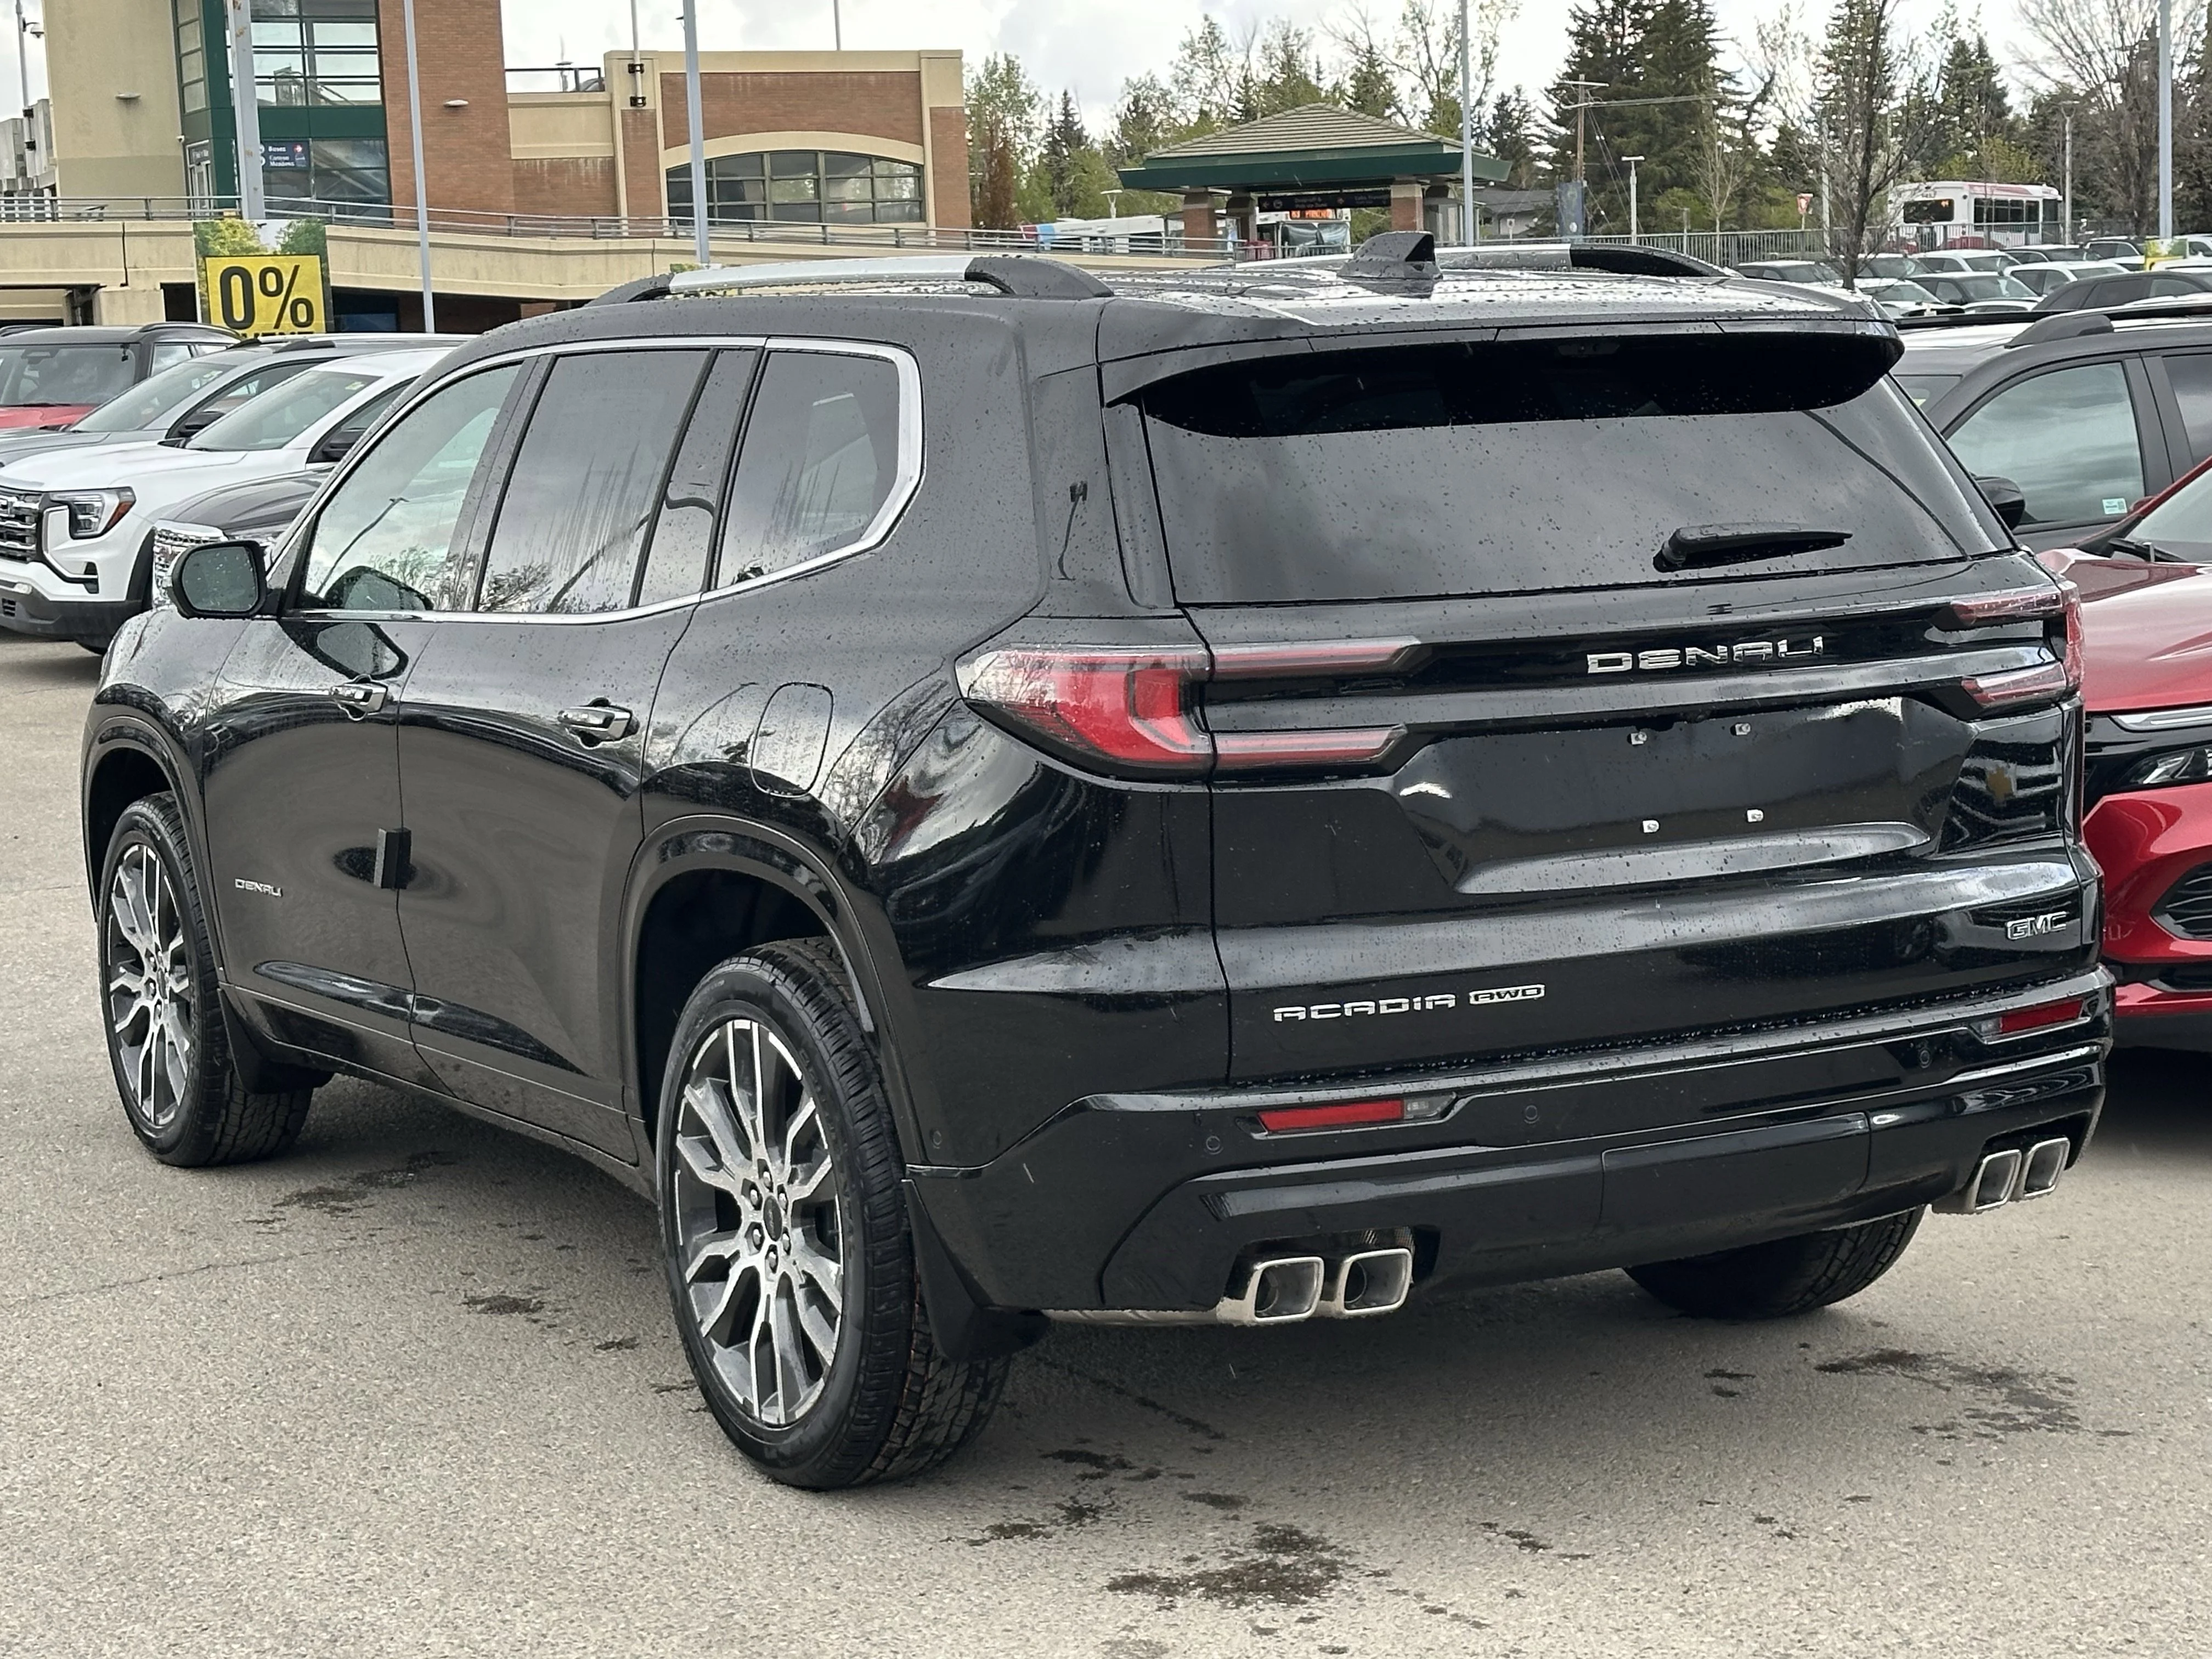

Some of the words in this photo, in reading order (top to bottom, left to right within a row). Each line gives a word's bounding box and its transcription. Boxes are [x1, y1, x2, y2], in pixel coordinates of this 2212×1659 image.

[220, 264, 314, 330] 0%
[1587, 636, 1823, 674] DENALI
[235, 878, 281, 897] DENALI
[2007, 911, 2068, 940] GMC
[1273, 994, 1457, 1022] ACADIA
[1470, 985, 1545, 1004] AWD
